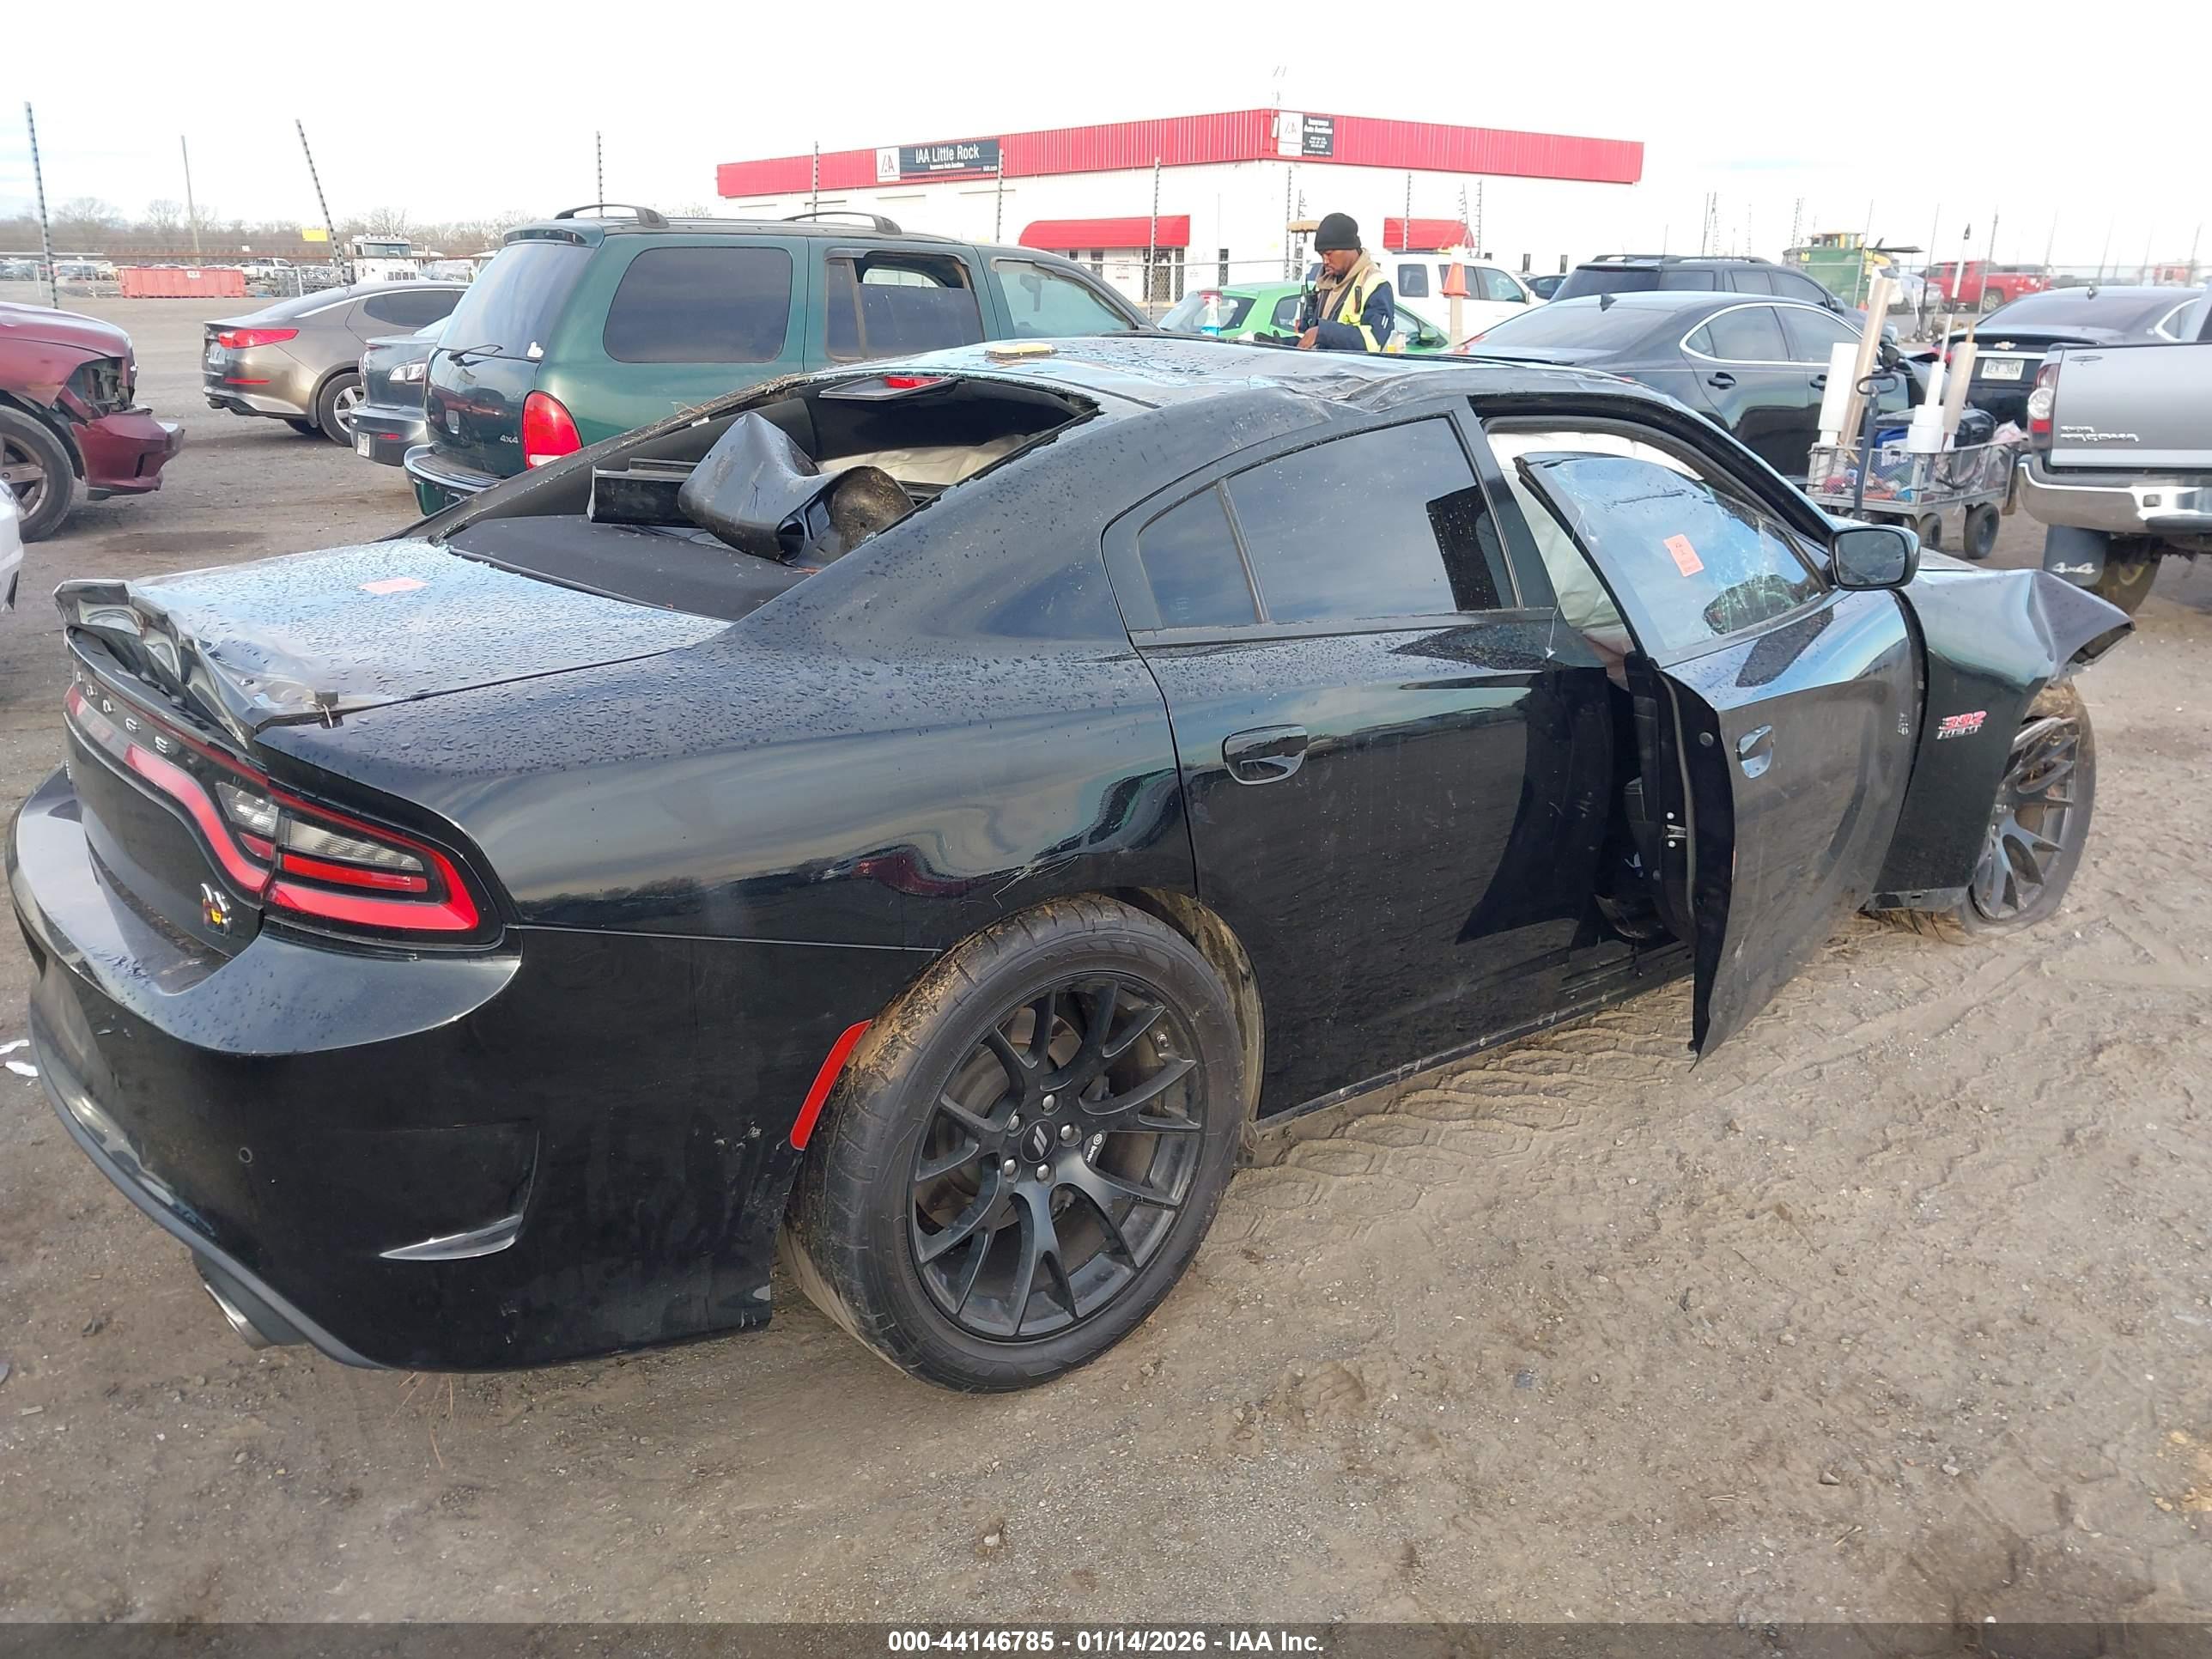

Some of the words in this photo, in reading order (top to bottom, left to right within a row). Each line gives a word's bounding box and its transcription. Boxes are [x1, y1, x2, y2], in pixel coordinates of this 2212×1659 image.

[915, 149, 930, 164] IAA
[932, 146, 954, 162] Little
[957, 143, 980, 160] Rock
[500, 434, 519, 443] 4x4
[1938, 710, 1987, 730] 392
